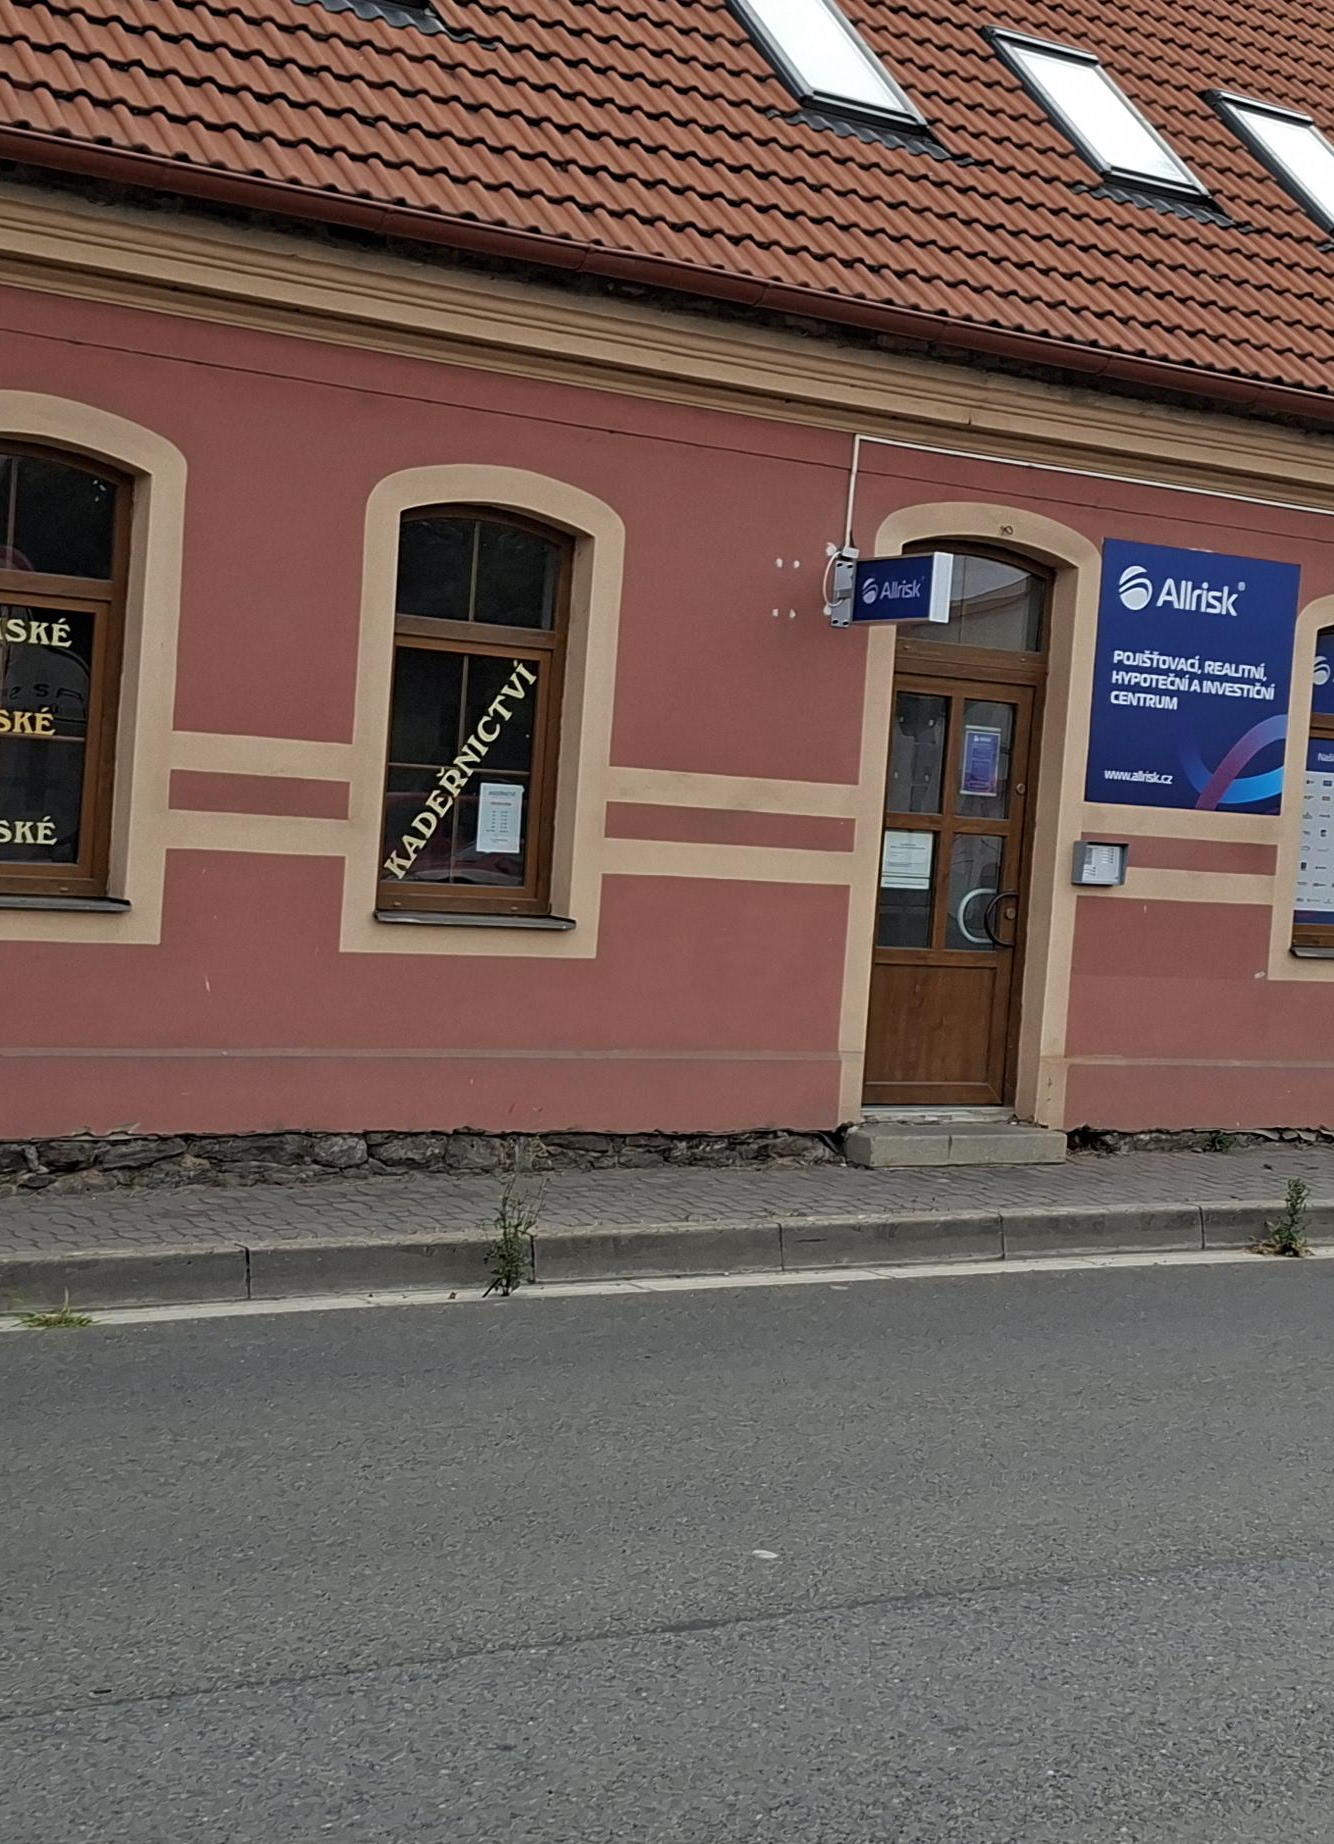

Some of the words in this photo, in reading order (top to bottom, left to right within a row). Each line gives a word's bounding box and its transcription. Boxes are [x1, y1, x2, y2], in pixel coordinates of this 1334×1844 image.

[879, 579, 922, 600] Allrisk
[1155, 578, 1238, 616] Allrisk
[1113, 650, 1202, 674] POJIŠŤOVACÍ,
[1204, 660, 1268, 682] REALITNÍ,
[1112, 670, 1190, 691] HYPOTEČNÍ
[1190, 679, 1200, 692] A
[1202, 681, 1275, 700] INVESTIČNÍ
[1110, 691, 1178, 710] CENTRUM
[384, 660, 538, 880] KADEŘNICTVÍ
[1104, 769, 1174, 785] www.allrisk.cz
